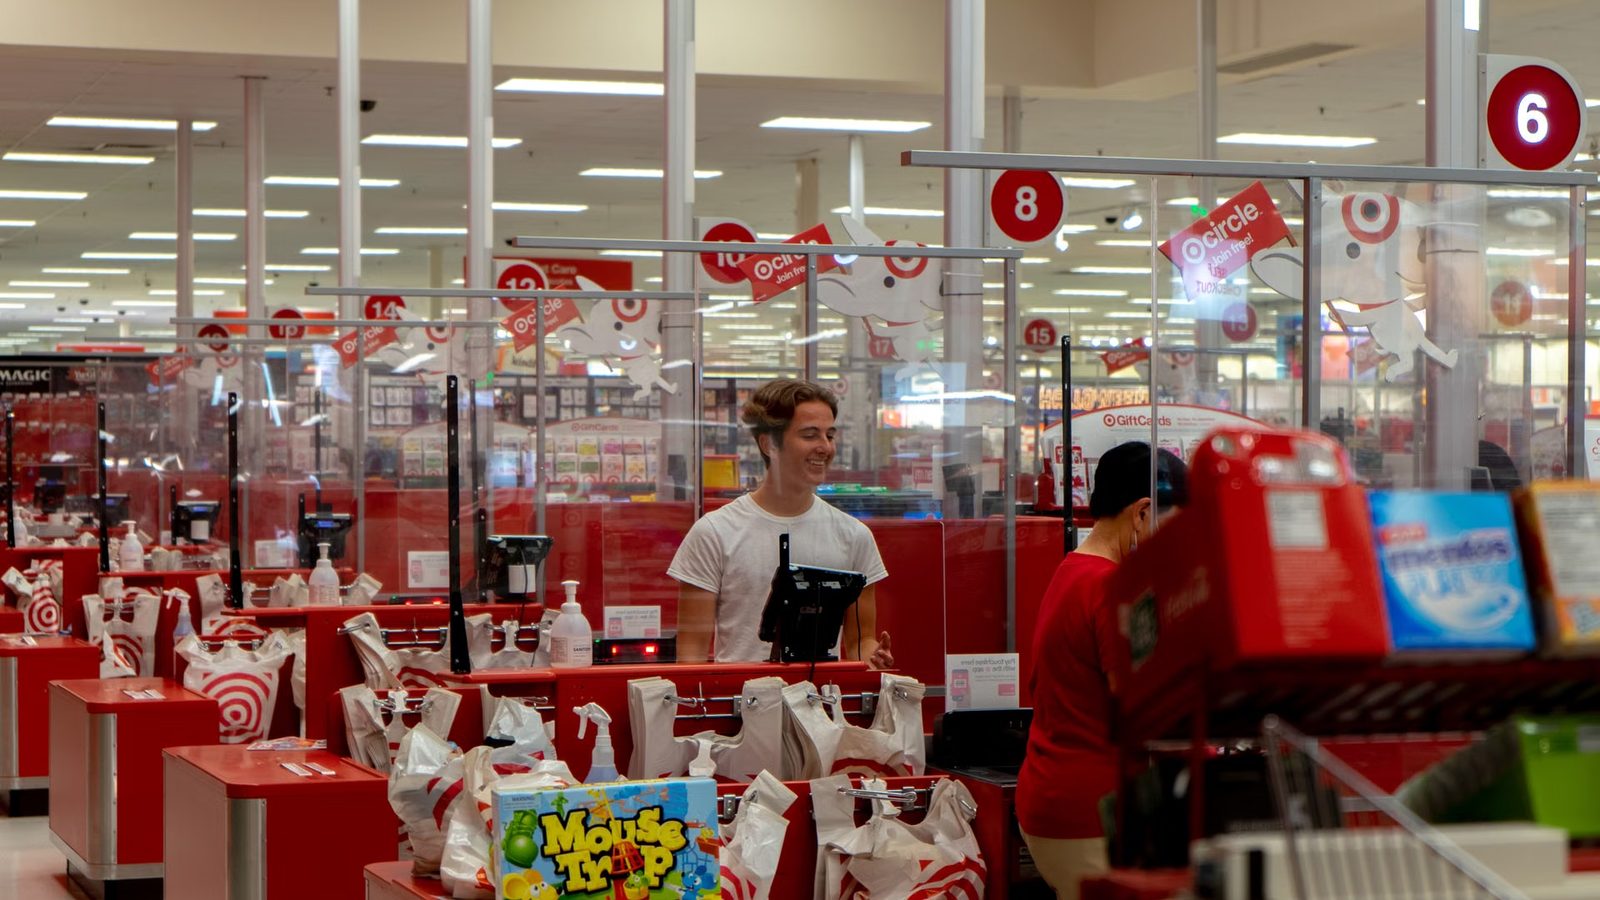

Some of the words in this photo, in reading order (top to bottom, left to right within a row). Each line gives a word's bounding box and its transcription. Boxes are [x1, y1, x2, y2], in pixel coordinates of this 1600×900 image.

[1516, 93, 1549, 143] 6
[1014, 185, 1039, 222] 8
[1202, 203, 1259, 248] circle
[1208, 248, 1233, 268] Join
[1230, 232, 1254, 255] free!
[371, 301, 398, 321] 14
[1030, 327, 1051, 345] 15
[0, 369, 50, 381] MAGIC
[1116, 414, 1172, 427] GiftCads
[541, 807, 688, 856] Mouse
